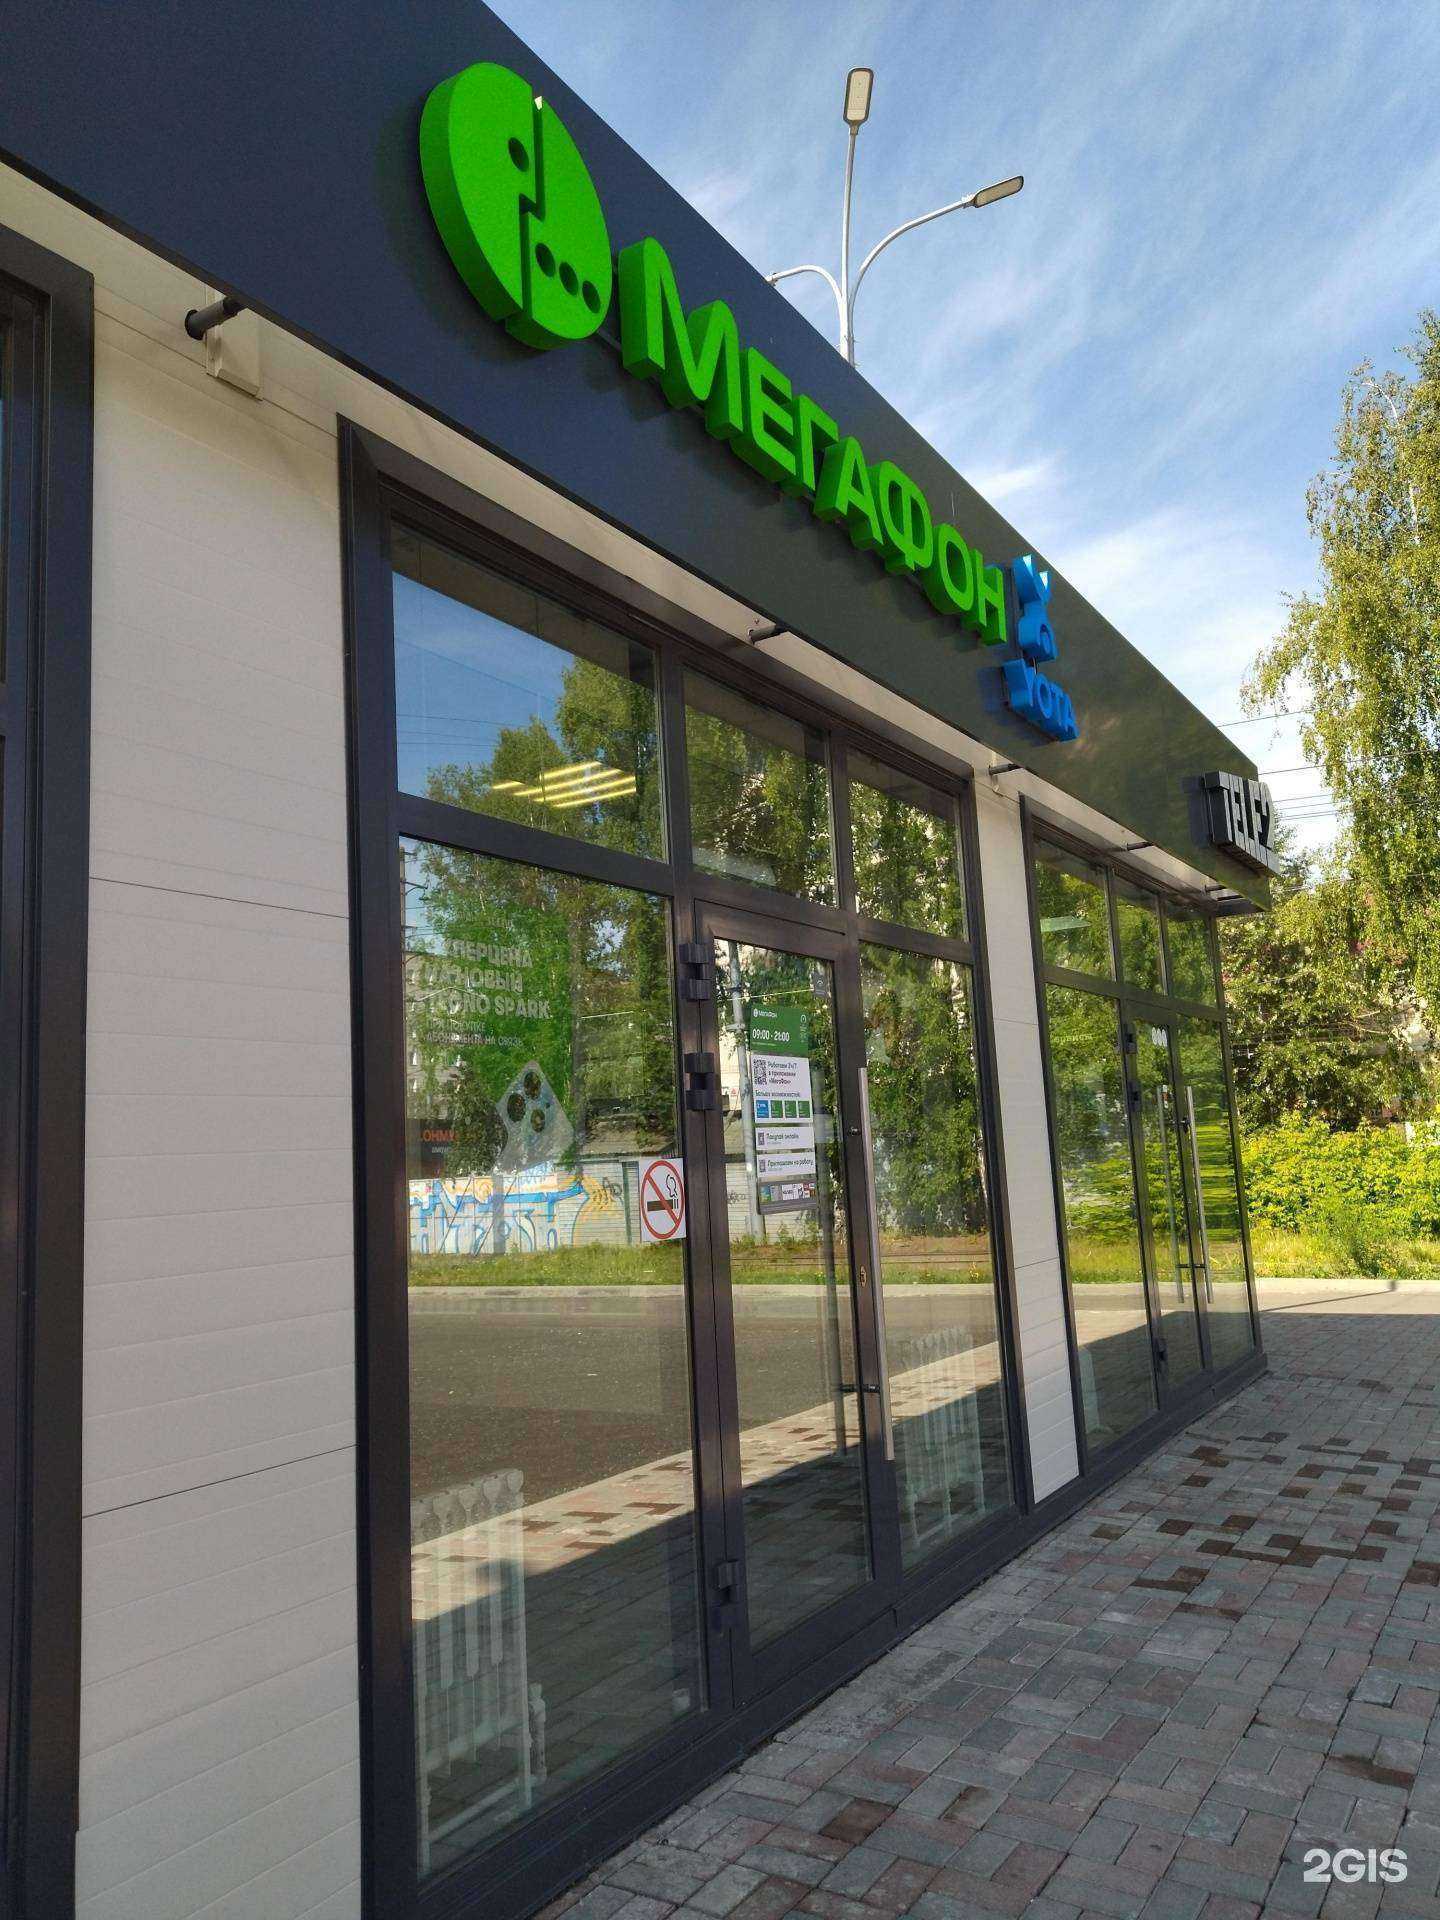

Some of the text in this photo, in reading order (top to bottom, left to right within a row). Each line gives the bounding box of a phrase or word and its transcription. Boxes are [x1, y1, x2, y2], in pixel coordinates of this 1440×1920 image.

[618, 236, 1007, 646] МЕГАФОН
[494, 995, 551, 1020] SPARK
[752, 1029, 770, 1040] 09:00
